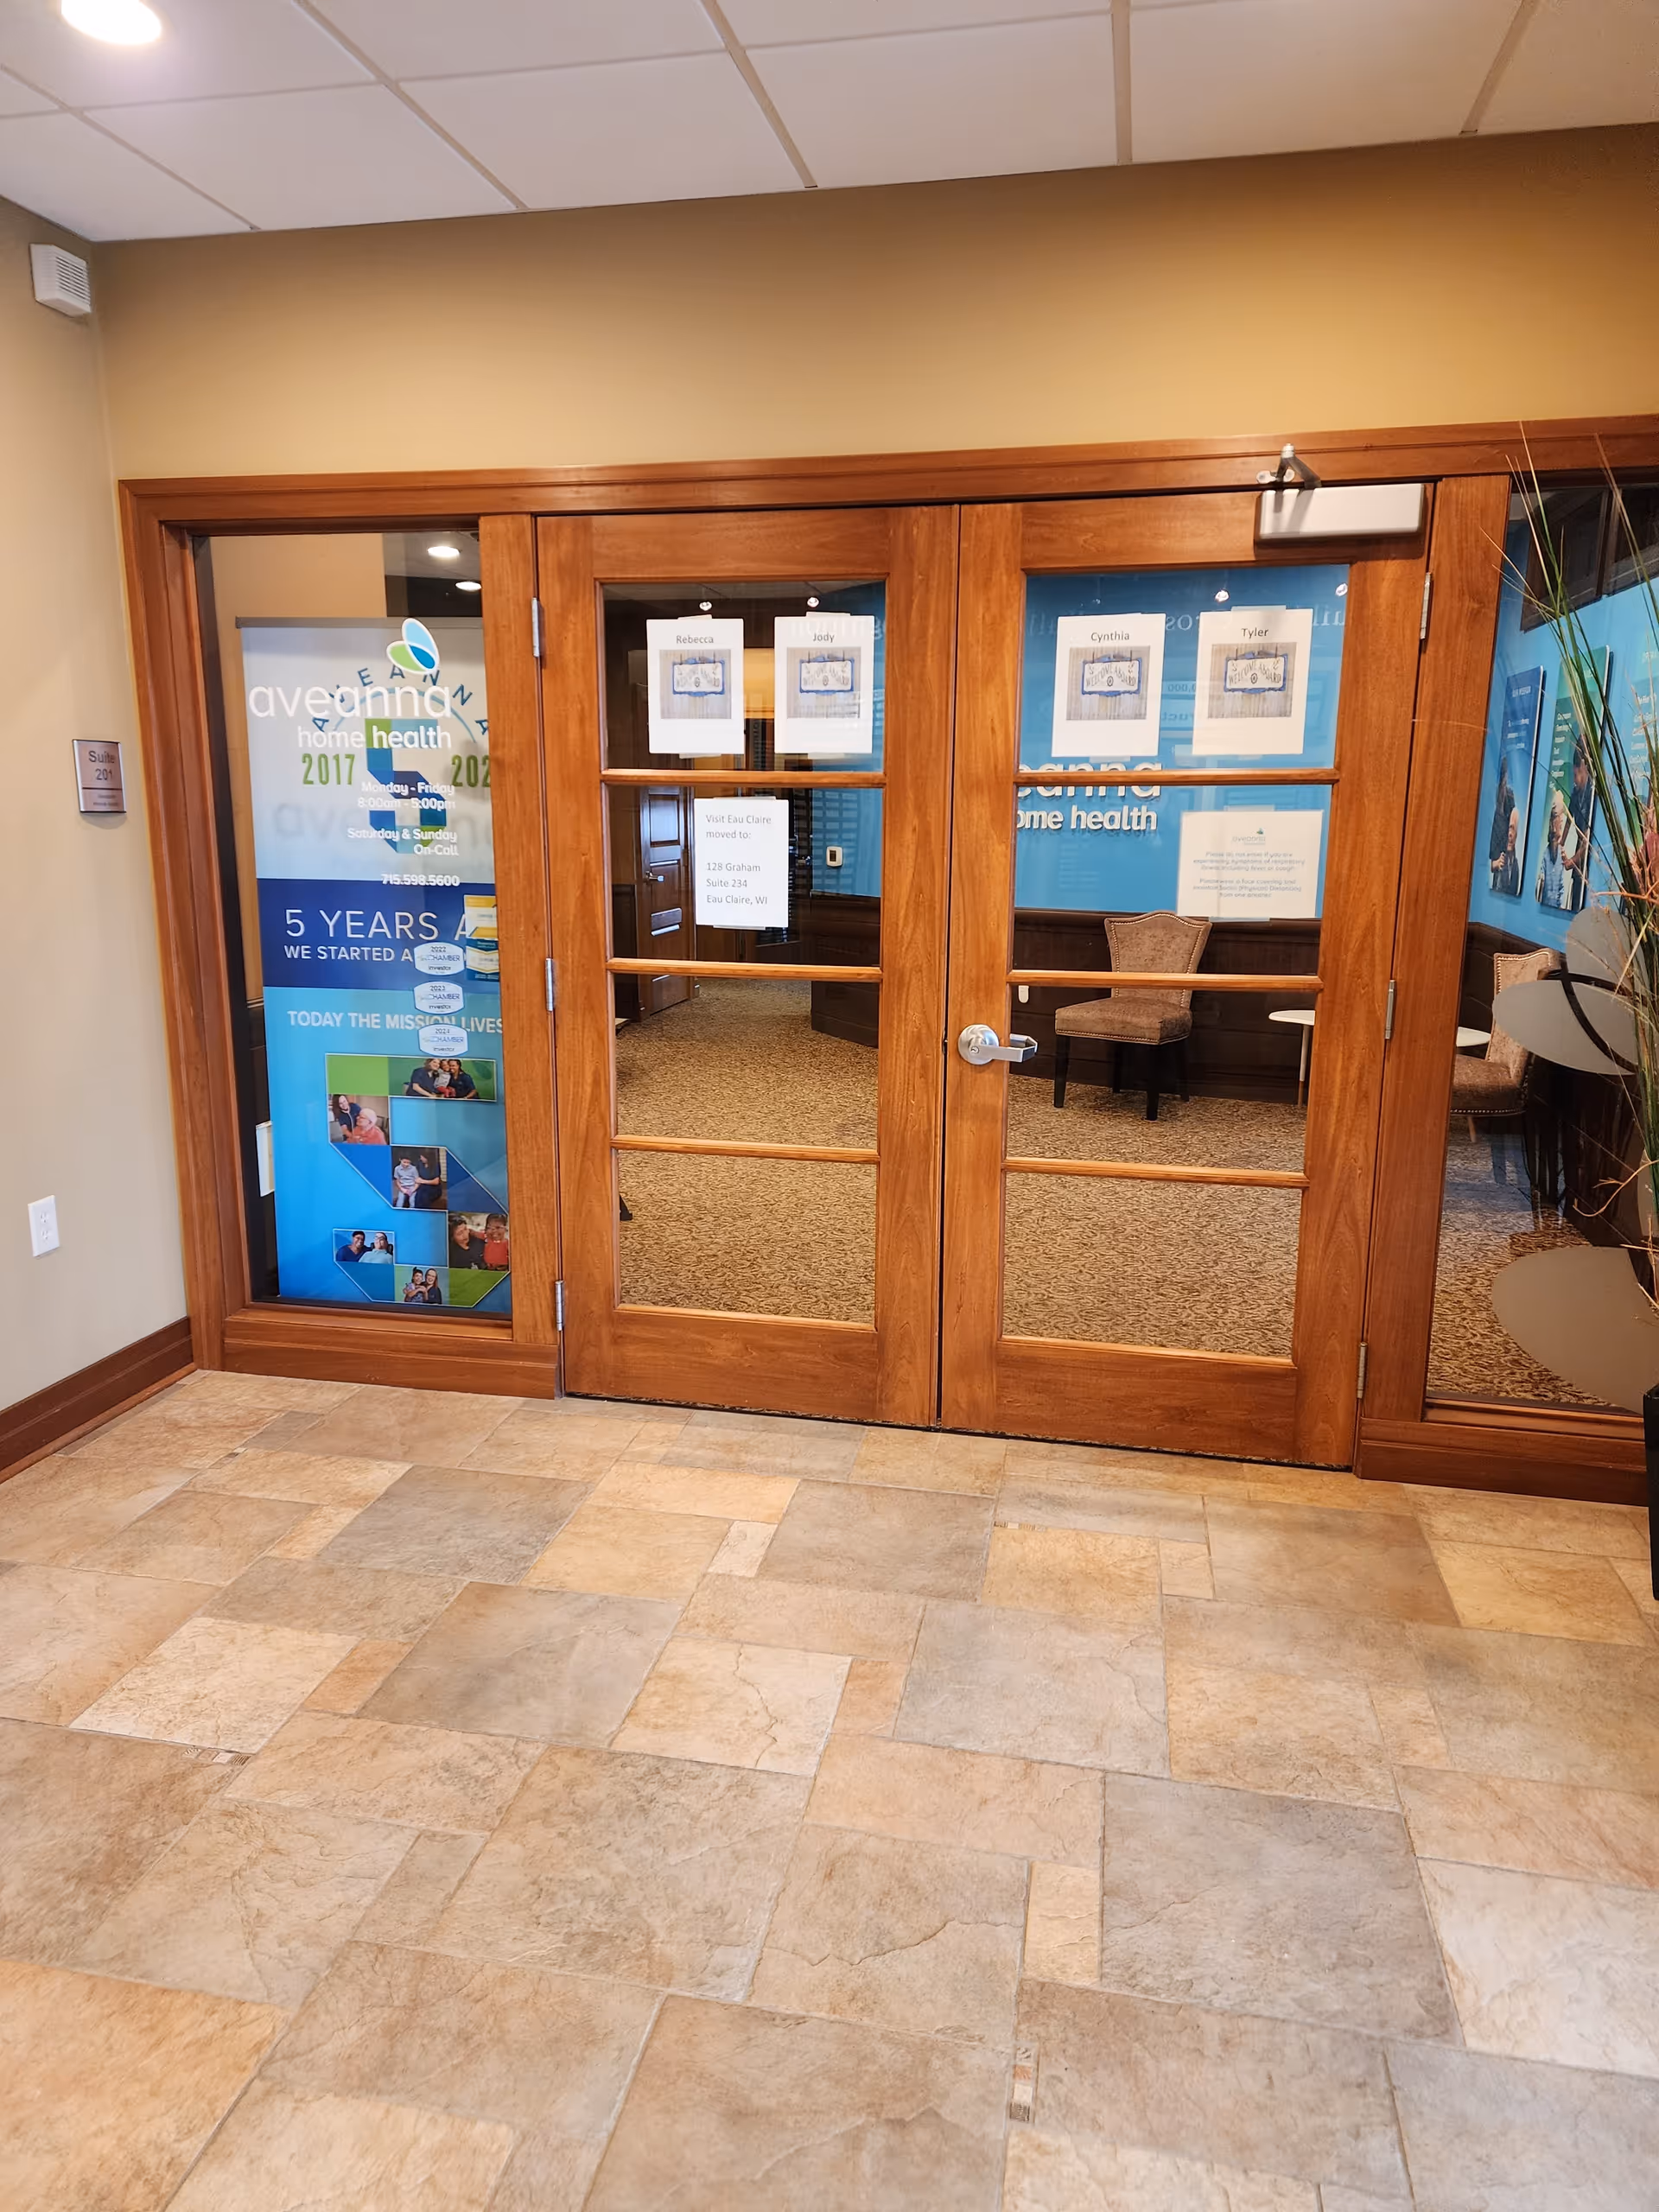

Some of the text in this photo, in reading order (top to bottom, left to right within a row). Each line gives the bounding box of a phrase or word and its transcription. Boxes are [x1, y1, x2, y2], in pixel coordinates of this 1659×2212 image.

[676, 634, 715, 644] Rebecca
[812, 632, 835, 643] Jody
[1090, 630, 1130, 643] Cynthia
[1242, 626, 1268, 639] Tyler
[248, 684, 452, 718] aveanna
[297, 725, 452, 749] home health
[88, 750, 116, 764] Suite
[95, 767, 112, 781] 201
[302, 753, 355, 785] 2017
[1018, 762, 1162, 798] eanna
[361, 782, 409, 795] Monday
[417, 782, 455, 795] Friday
[357, 798, 401, 809] 8:00am
[411, 798, 455, 811] 5:00pm
[705, 814, 772, 824] Visit Eau Claire
[1017, 804, 1158, 830] ome health
[347, 828, 457, 842] Saturday & Sunday
[706, 830, 752, 839] moved to:
[413, 844, 459, 856] On-Call
[707, 862, 761, 872] 128 Graham
[380, 874, 461, 887] 715.598.5600
[706, 878, 747, 887] Suite 234
[706, 894, 768, 906] Eau Claire, WI
[285, 909, 305, 938] 5
[319, 910, 439, 941] YEARS
[283, 945, 312, 959] WE
[317, 945, 395, 962] STARTED
[287, 1010, 503, 1033] TODAY THE MISSION LIVES
